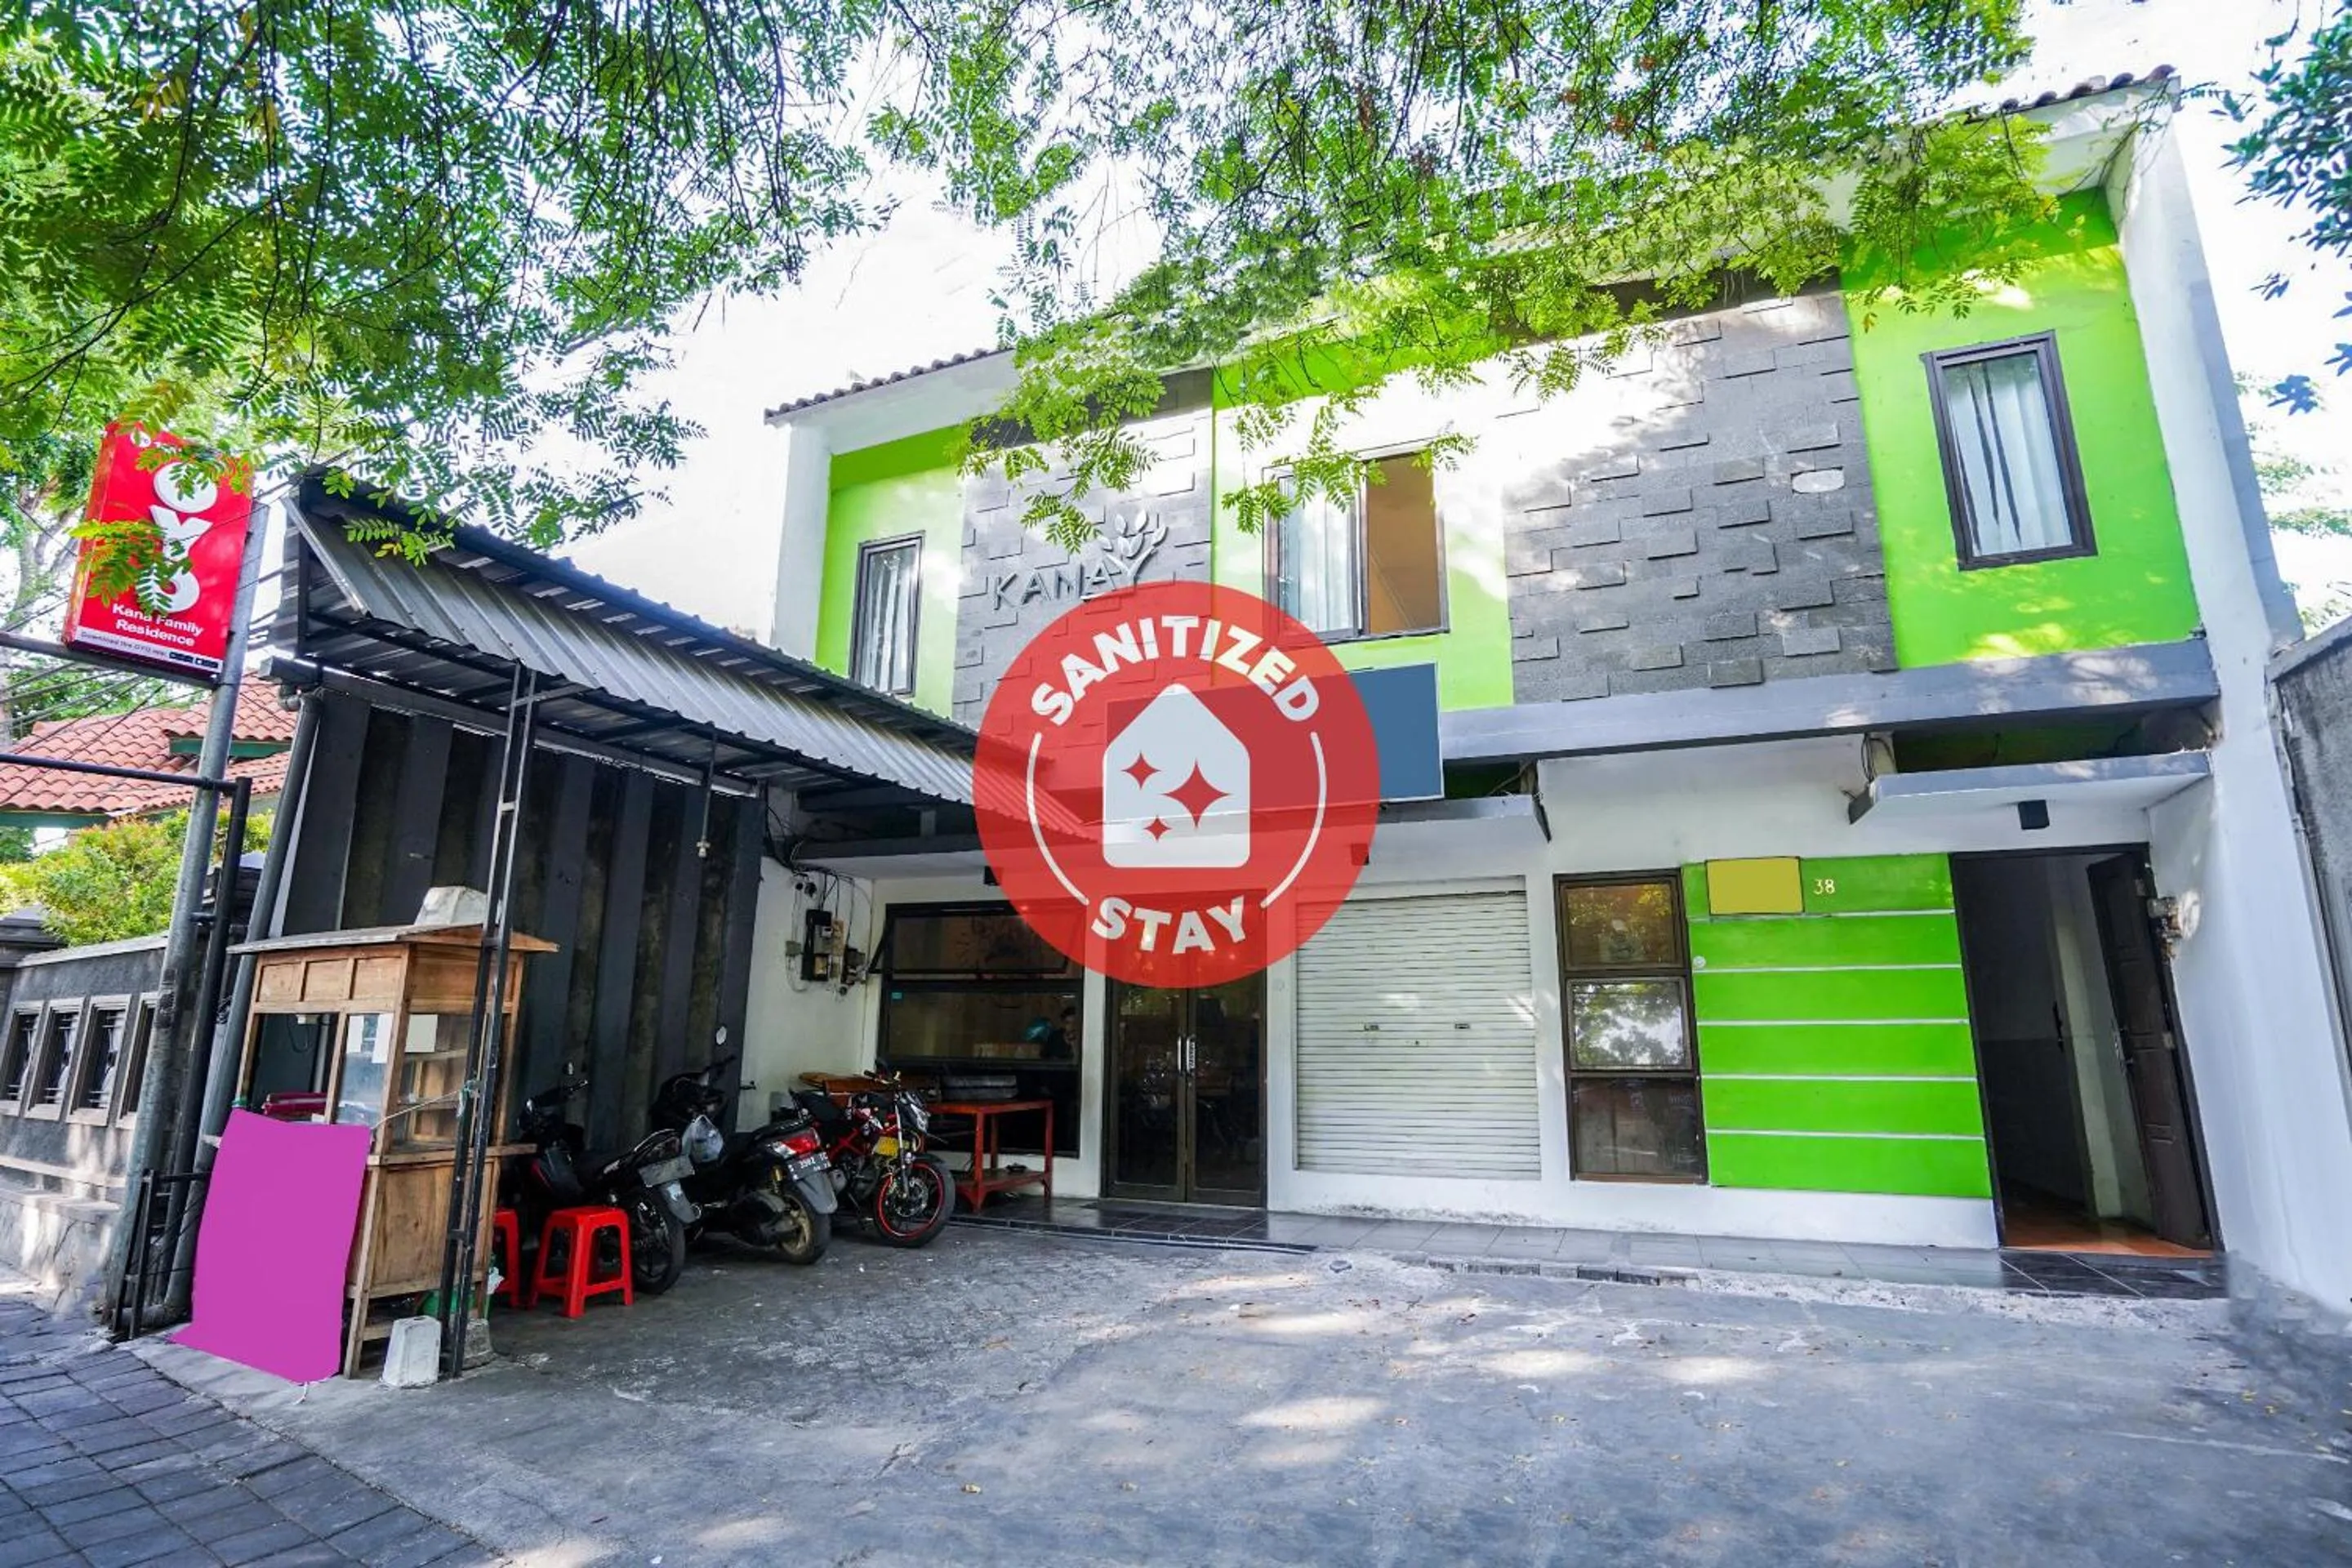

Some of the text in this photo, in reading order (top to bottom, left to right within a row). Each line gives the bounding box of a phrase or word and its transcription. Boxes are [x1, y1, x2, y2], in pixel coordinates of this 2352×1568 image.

[136, 461, 218, 612] OYO
[111, 603, 203, 638] Kana Family
[115, 618, 195, 647] Residence
[1813, 878, 1836, 895] 38
